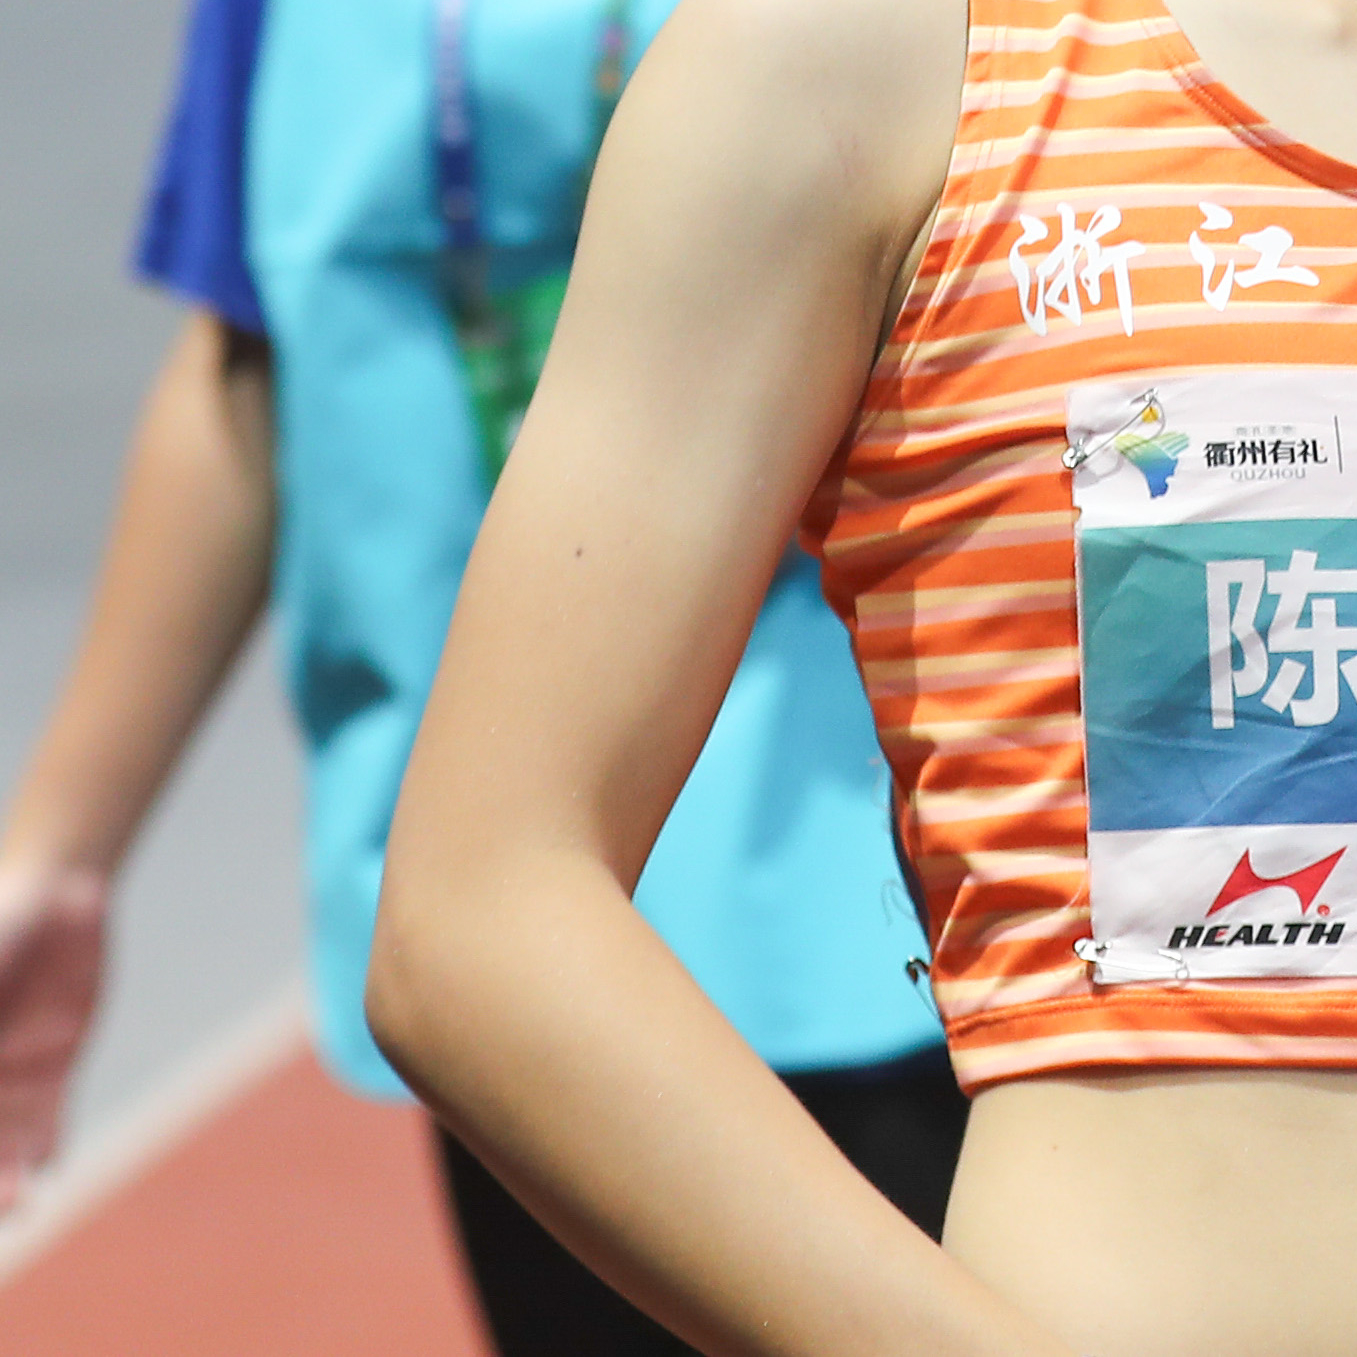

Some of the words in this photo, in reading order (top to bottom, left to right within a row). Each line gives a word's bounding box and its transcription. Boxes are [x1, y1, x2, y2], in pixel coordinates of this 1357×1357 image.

[1009, 202, 1320, 336] 浙江
[1204, 439, 1328, 468] 衢州有礼
[1231, 468, 1306, 481] QUZHOU
[1168, 921, 1346, 949] HEALTH
